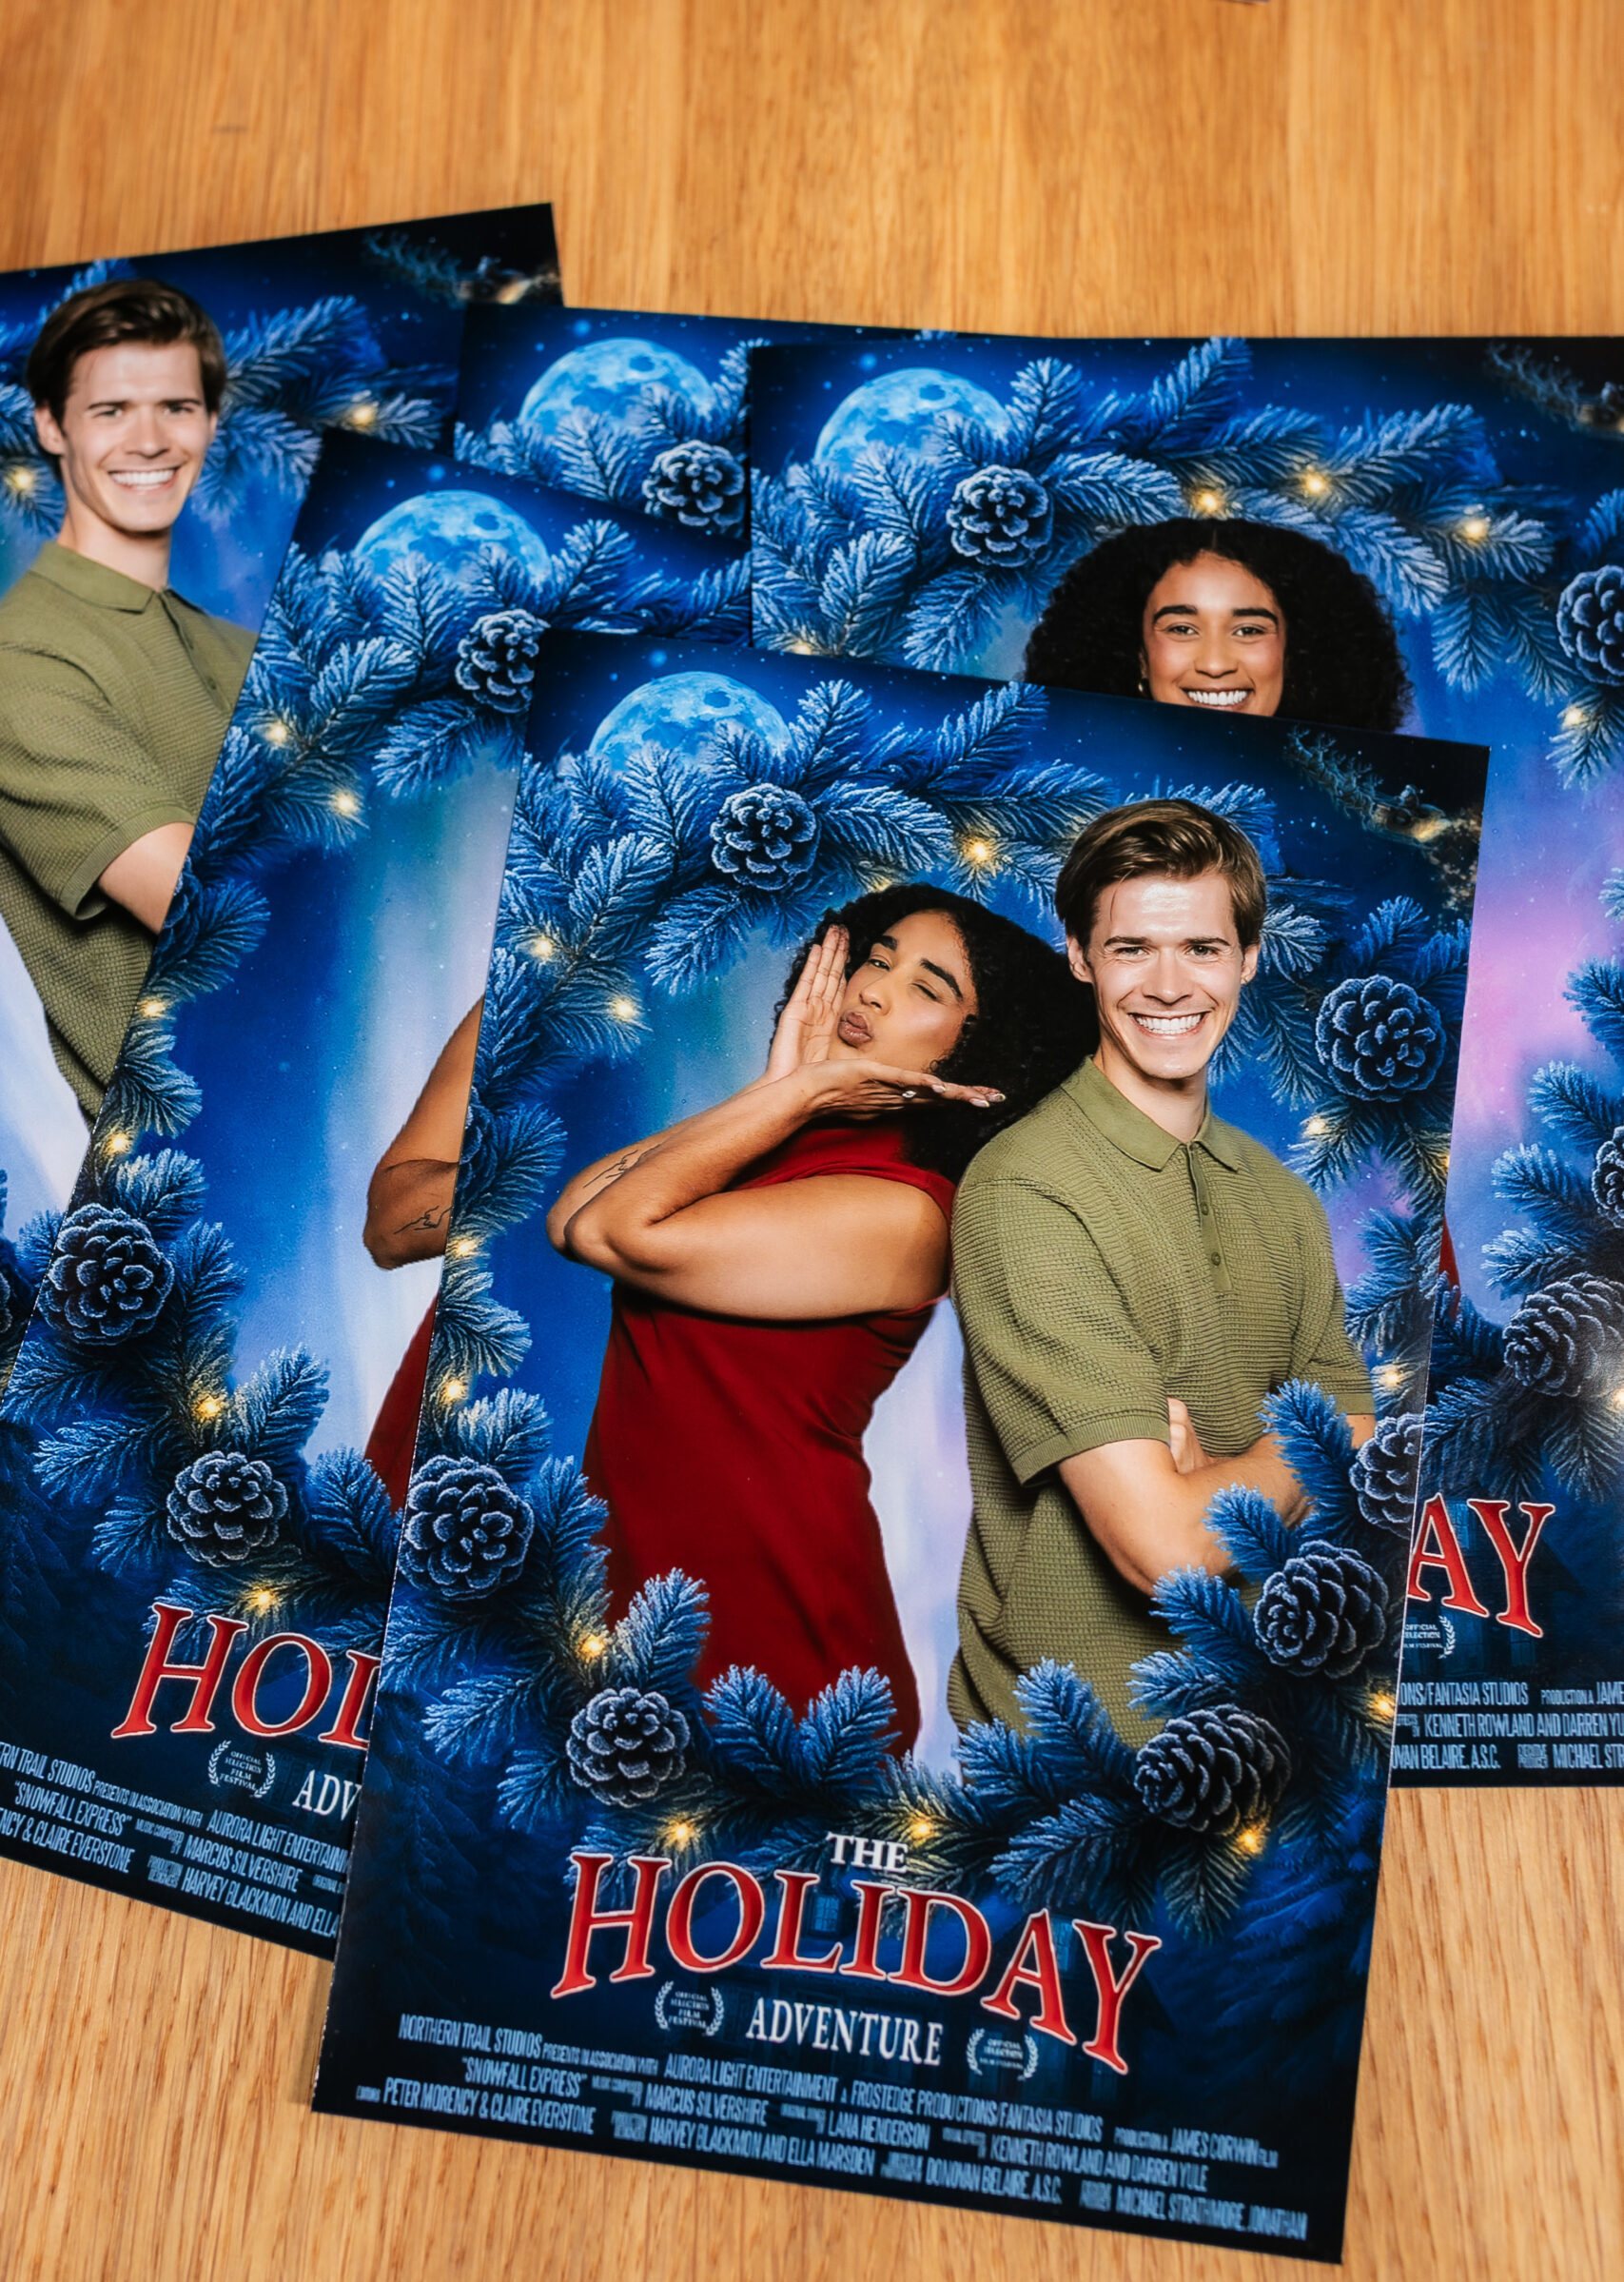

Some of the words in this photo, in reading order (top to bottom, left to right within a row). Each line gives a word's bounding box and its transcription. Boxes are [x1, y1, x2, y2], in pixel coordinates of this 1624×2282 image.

[1481, 1682, 1529, 1706] STUDIOS
[1423, 1713, 1477, 1738] KENNETH
[1477, 1712, 1536, 1738] ROWLAND
[1536, 1712, 1562, 1738] AND
[1561, 1712, 1609, 1738] DARREN
[229, 1767, 251, 1780] FILM
[1470, 1743, 1501, 1769] A.S.C.
[1552, 1743, 1604, 1769] MICHAEL
[16, 1748, 49, 1780] TRAIL
[47, 1758, 96, 1794] STUDIOS
[91, 1780, 130, 1805] PRESENTS
[205, 1808, 254, 1844] AURORA
[250, 1821, 288, 1854] LIGHT
[219, 1772, 258, 1792] FESTIVAL
[21, 1817, 35, 1842] &
[31, 1820, 75, 1855] CLAIRE
[68, 1831, 136, 1874] EVERSTONE
[180, 1866, 229, 1902] HARVEY
[224, 1879, 292, 1923] BLACKMON
[285, 1900, 315, 1931] AND
[182, 1834, 234, 1871] MARCUS
[230, 1849, 303, 1894] SILVERSHIRE
[826, 1831, 910, 1875] THE
[550, 1851, 1163, 2075] HOLIDAY
[745, 1997, 944, 2067] ADVENTURE
[460, 2021, 492, 2053] TRAIL
[493, 2027, 543, 2059] STUDIOS
[663, 2053, 712, 2084] AURORA
[711, 2059, 747, 2089] LIGHT
[744, 2063, 839, 2103] ENTERTAINMENT
[382, 2076, 421, 2109] PETER
[420, 2081, 480, 2116] MORENCY
[478, 2091, 490, 2119] &
[489, 2092, 532, 2126] CLAIRE
[529, 2097, 597, 2135] EVERSTONE
[644, 2082, 696, 2115] MARCUS
